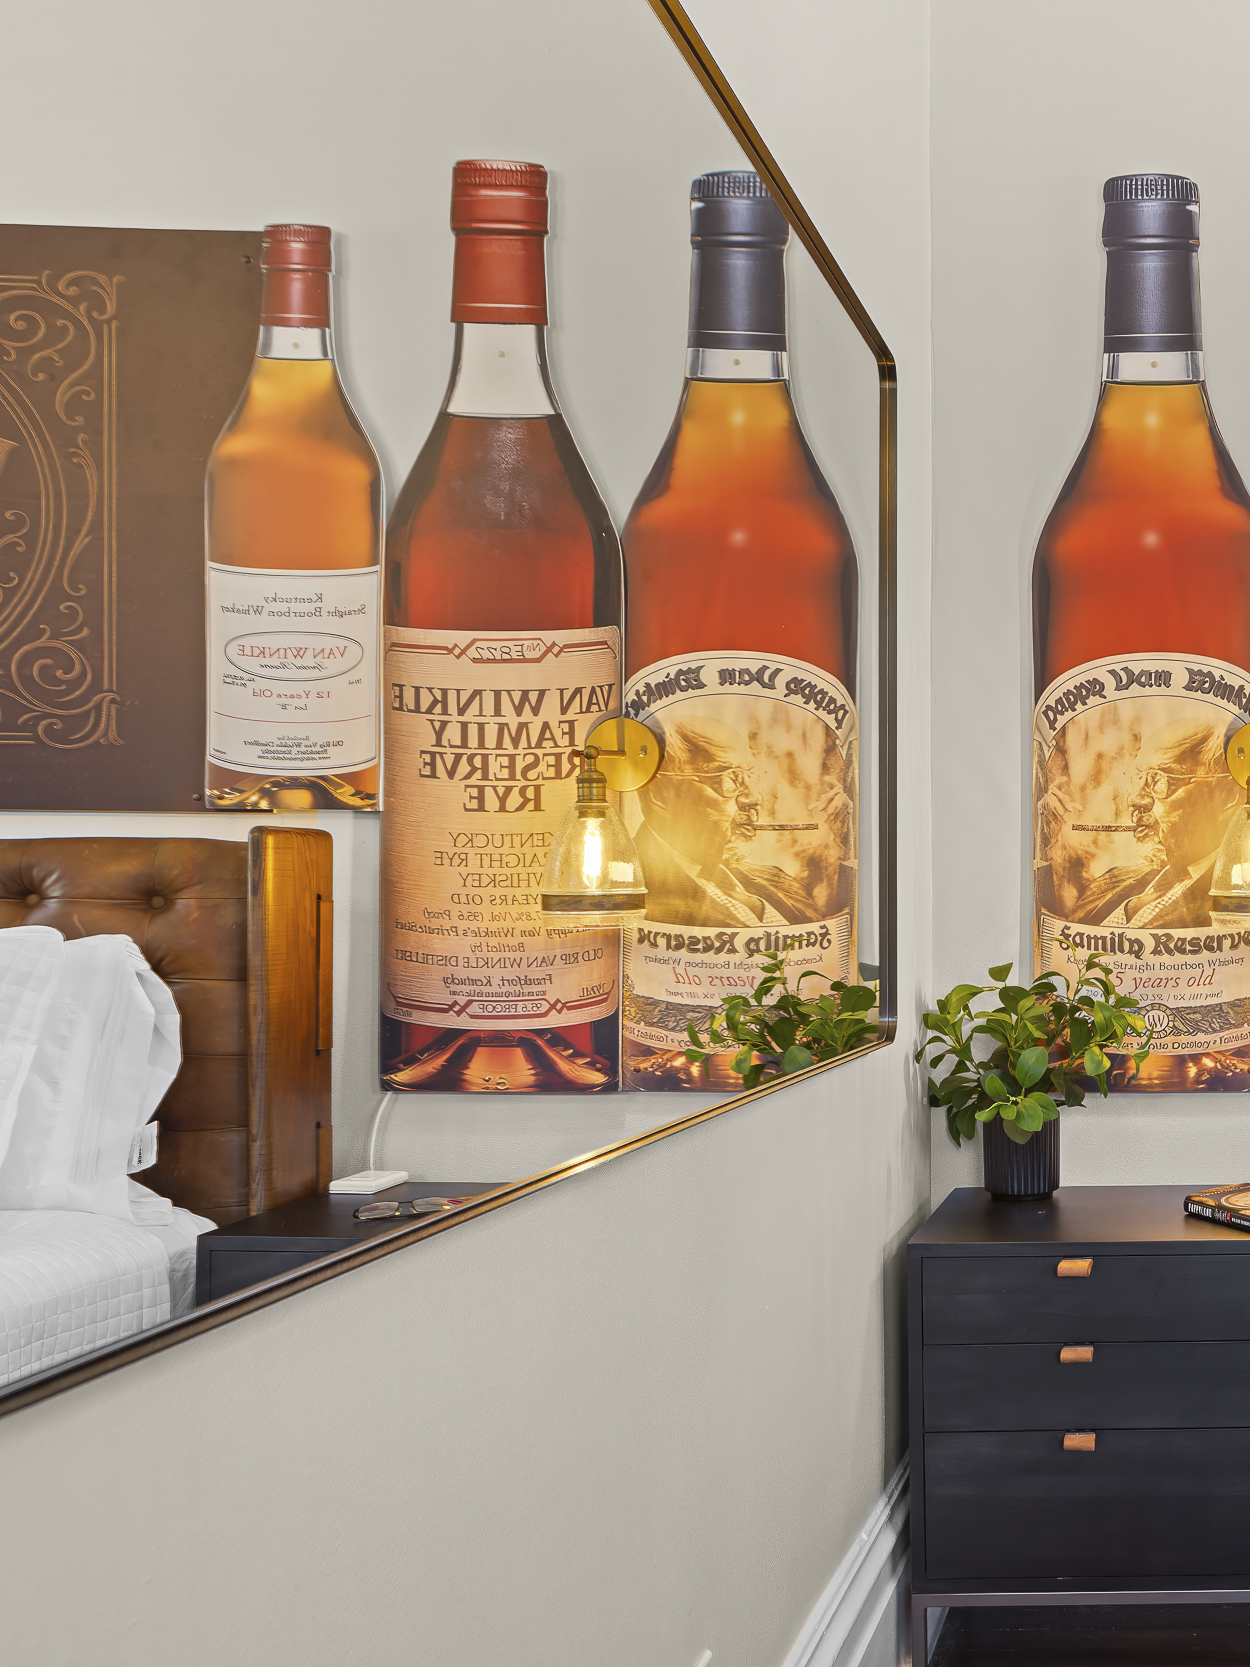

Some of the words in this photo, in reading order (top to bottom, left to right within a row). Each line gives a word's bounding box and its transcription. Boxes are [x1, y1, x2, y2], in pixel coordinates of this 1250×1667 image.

[1107, 666, 1173, 692] Van
[1131, 975, 1181, 993] years
[1186, 967, 1216, 988] old
